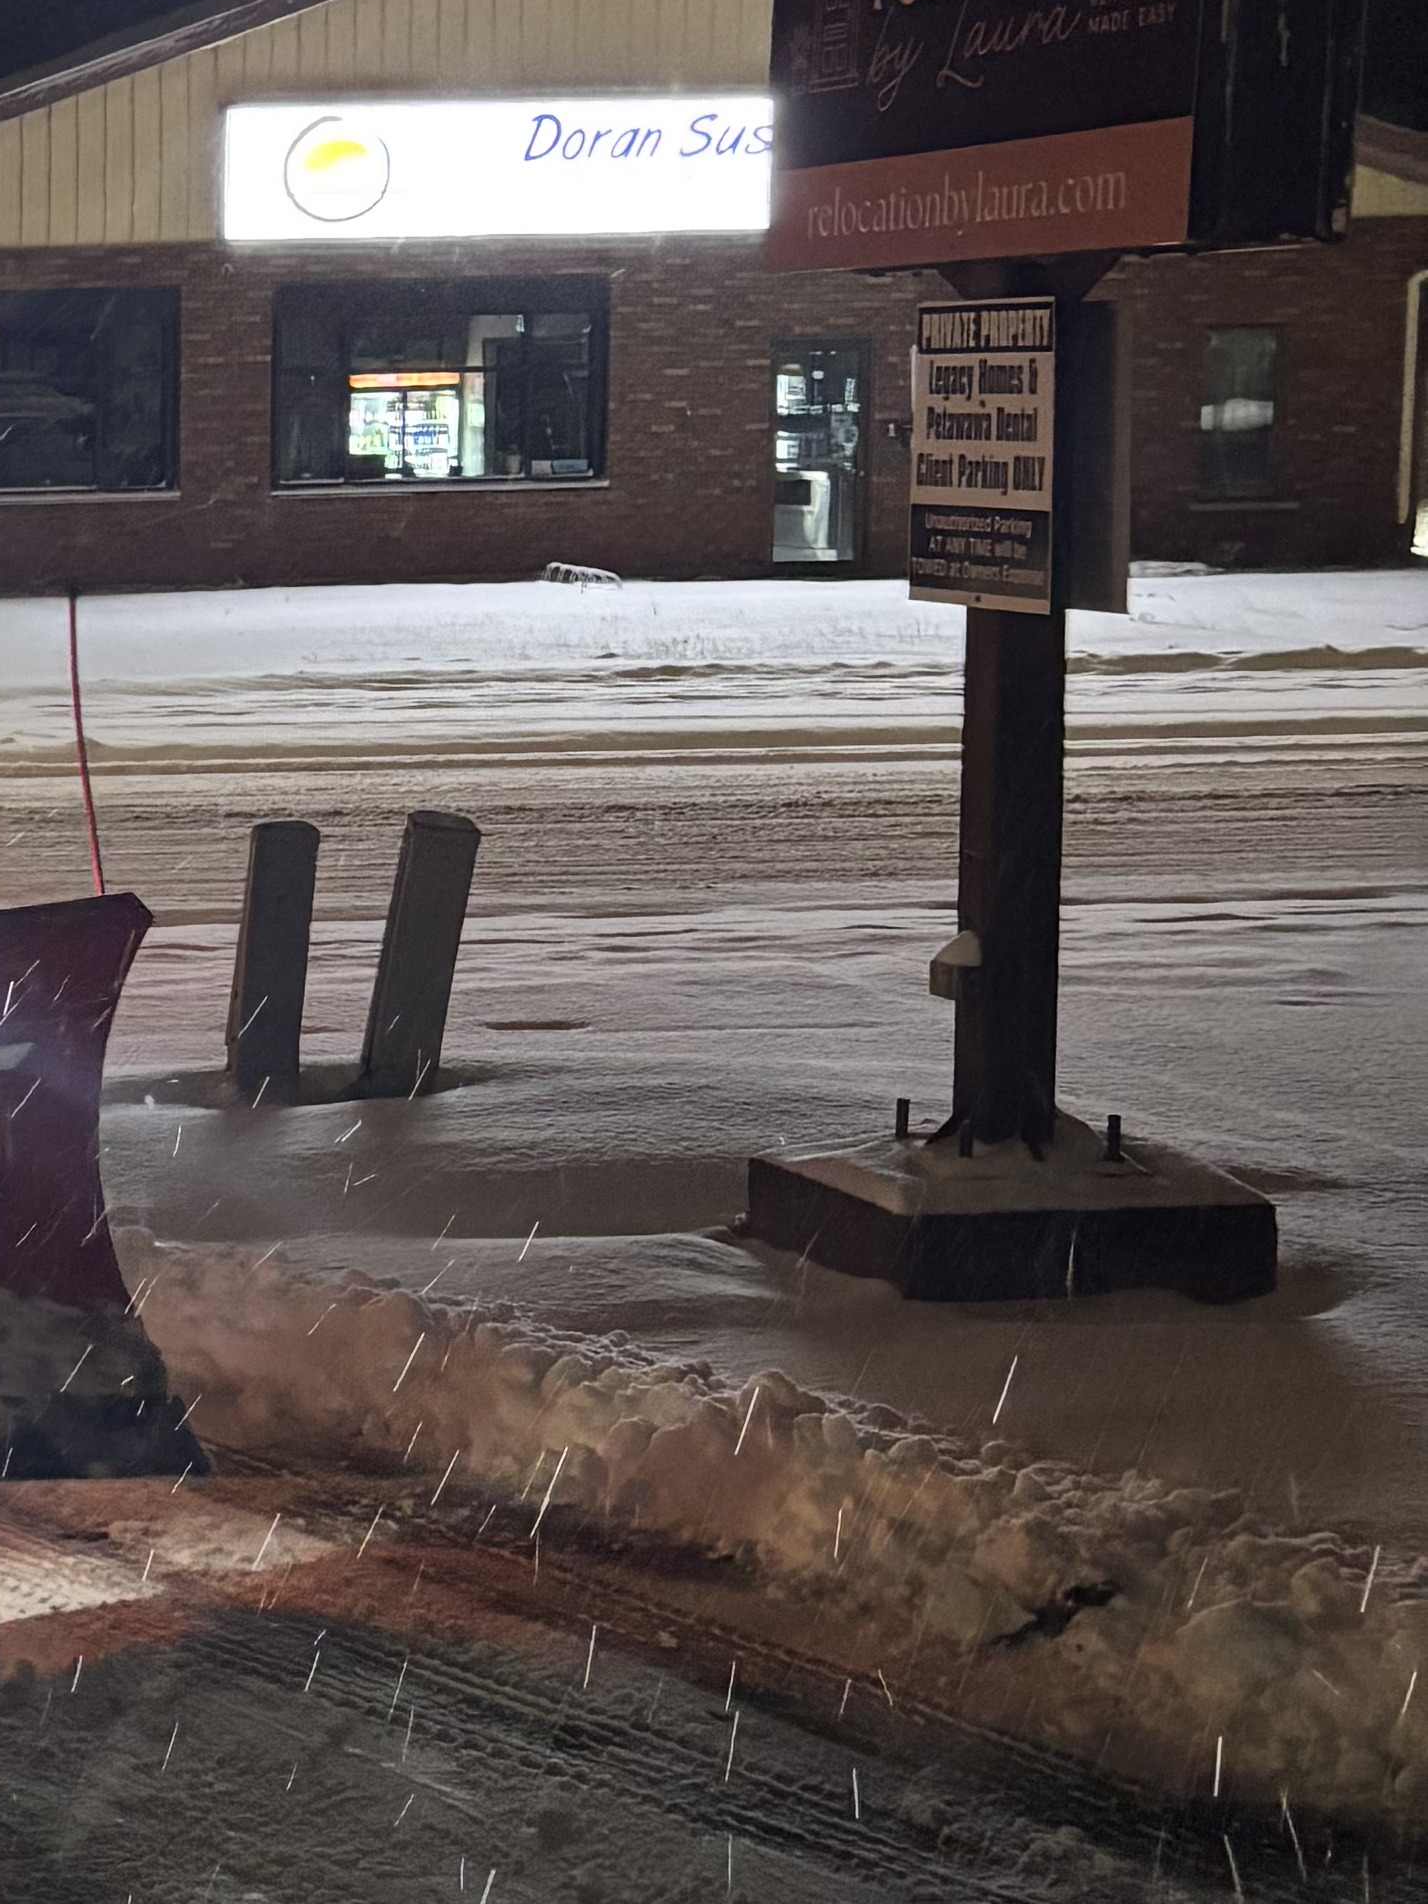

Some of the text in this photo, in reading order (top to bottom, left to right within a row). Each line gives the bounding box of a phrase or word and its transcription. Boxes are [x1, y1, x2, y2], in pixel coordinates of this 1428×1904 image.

[1087, 2, 1178, 35] MADE EASY
[865, 4, 924, 112] by
[523, 112, 663, 162] Doran
[806, 168, 1129, 242] relocationbylaura.com
[921, 308, 1051, 350] PRIVATE PROPERTY
[929, 359, 973, 401] Legacy
[979, 358, 1023, 394] Homes
[926, 407, 1037, 442] Petawawa Dental
[958, 454, 1008, 496] Parking
[1013, 456, 1046, 492] ONLY
